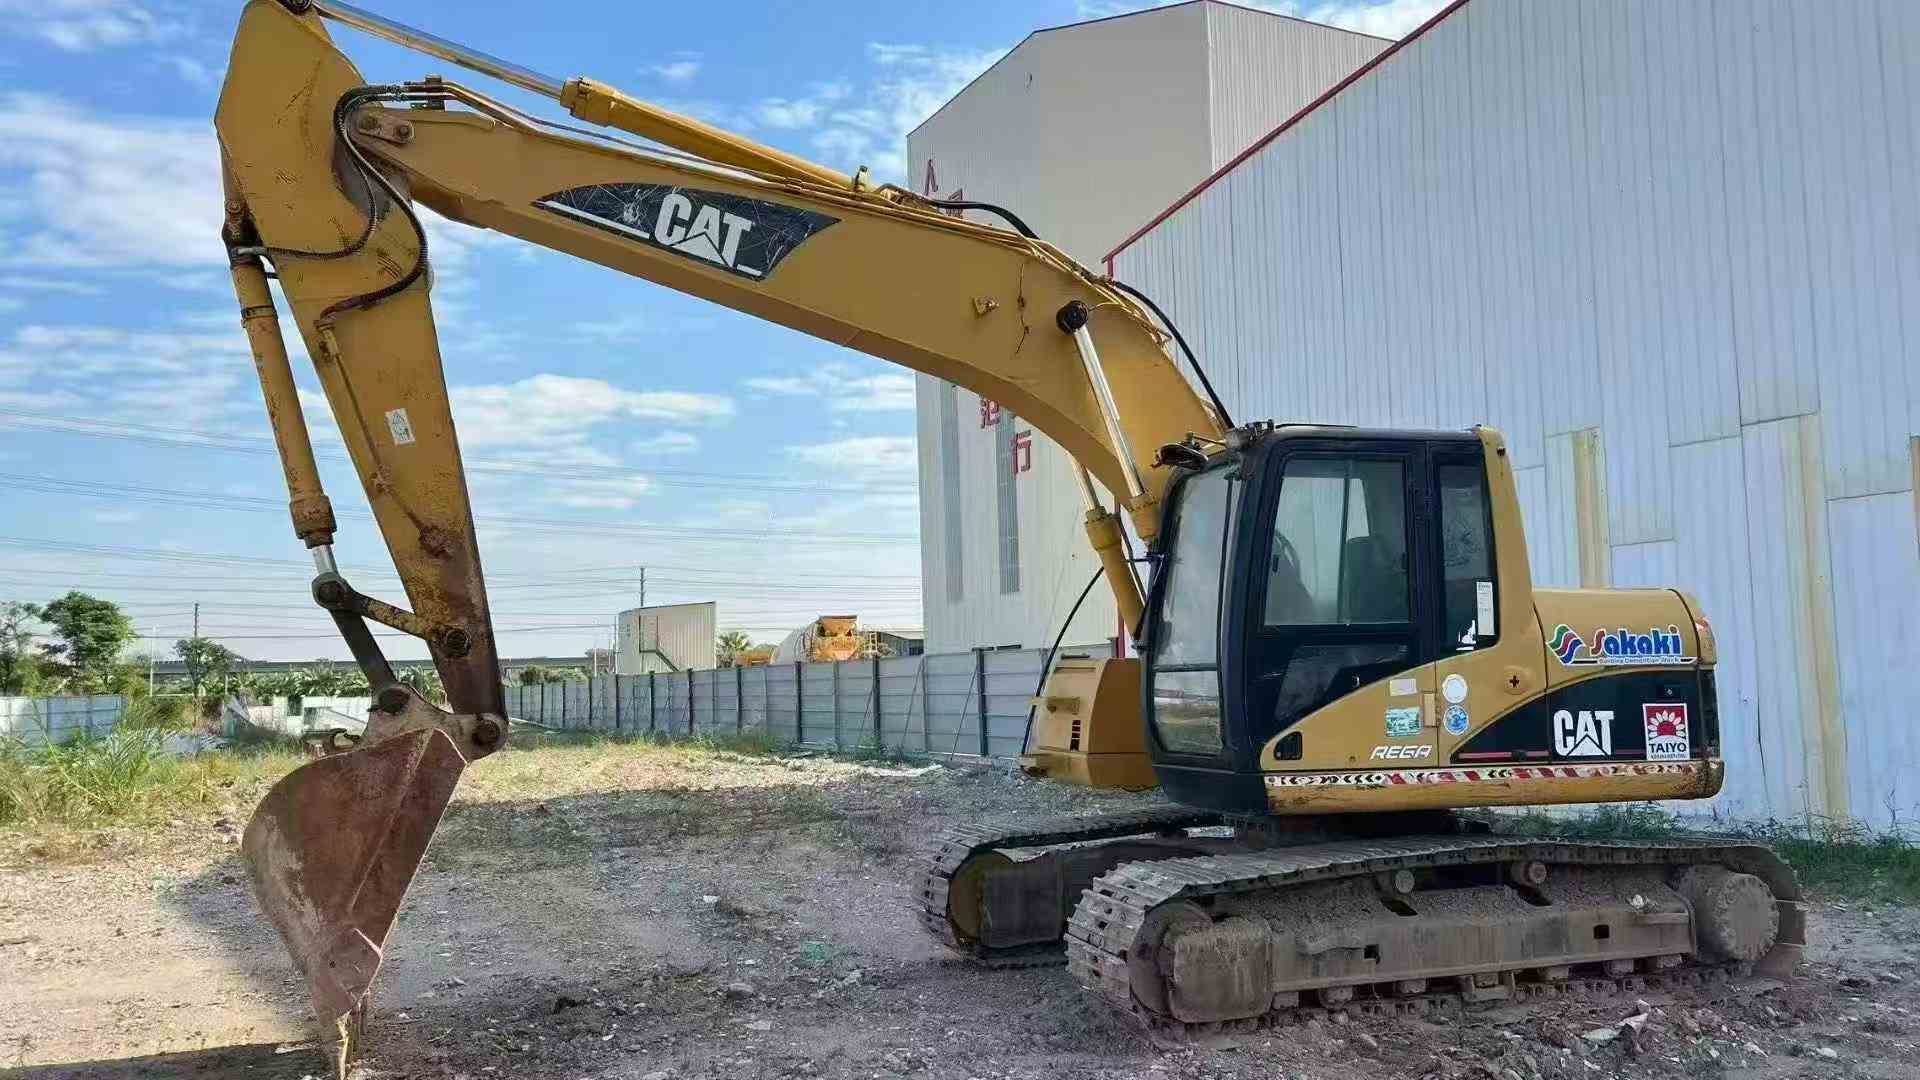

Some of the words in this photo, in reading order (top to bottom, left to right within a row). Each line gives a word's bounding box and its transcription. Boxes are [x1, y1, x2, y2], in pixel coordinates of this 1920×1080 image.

[654, 193, 752, 268] CAT
[1590, 625, 1682, 656] Sakaki
[1553, 709, 1615, 757] CAT
[1648, 742, 1687, 753] TAIYO
[1369, 744, 1433, 760] REGA
